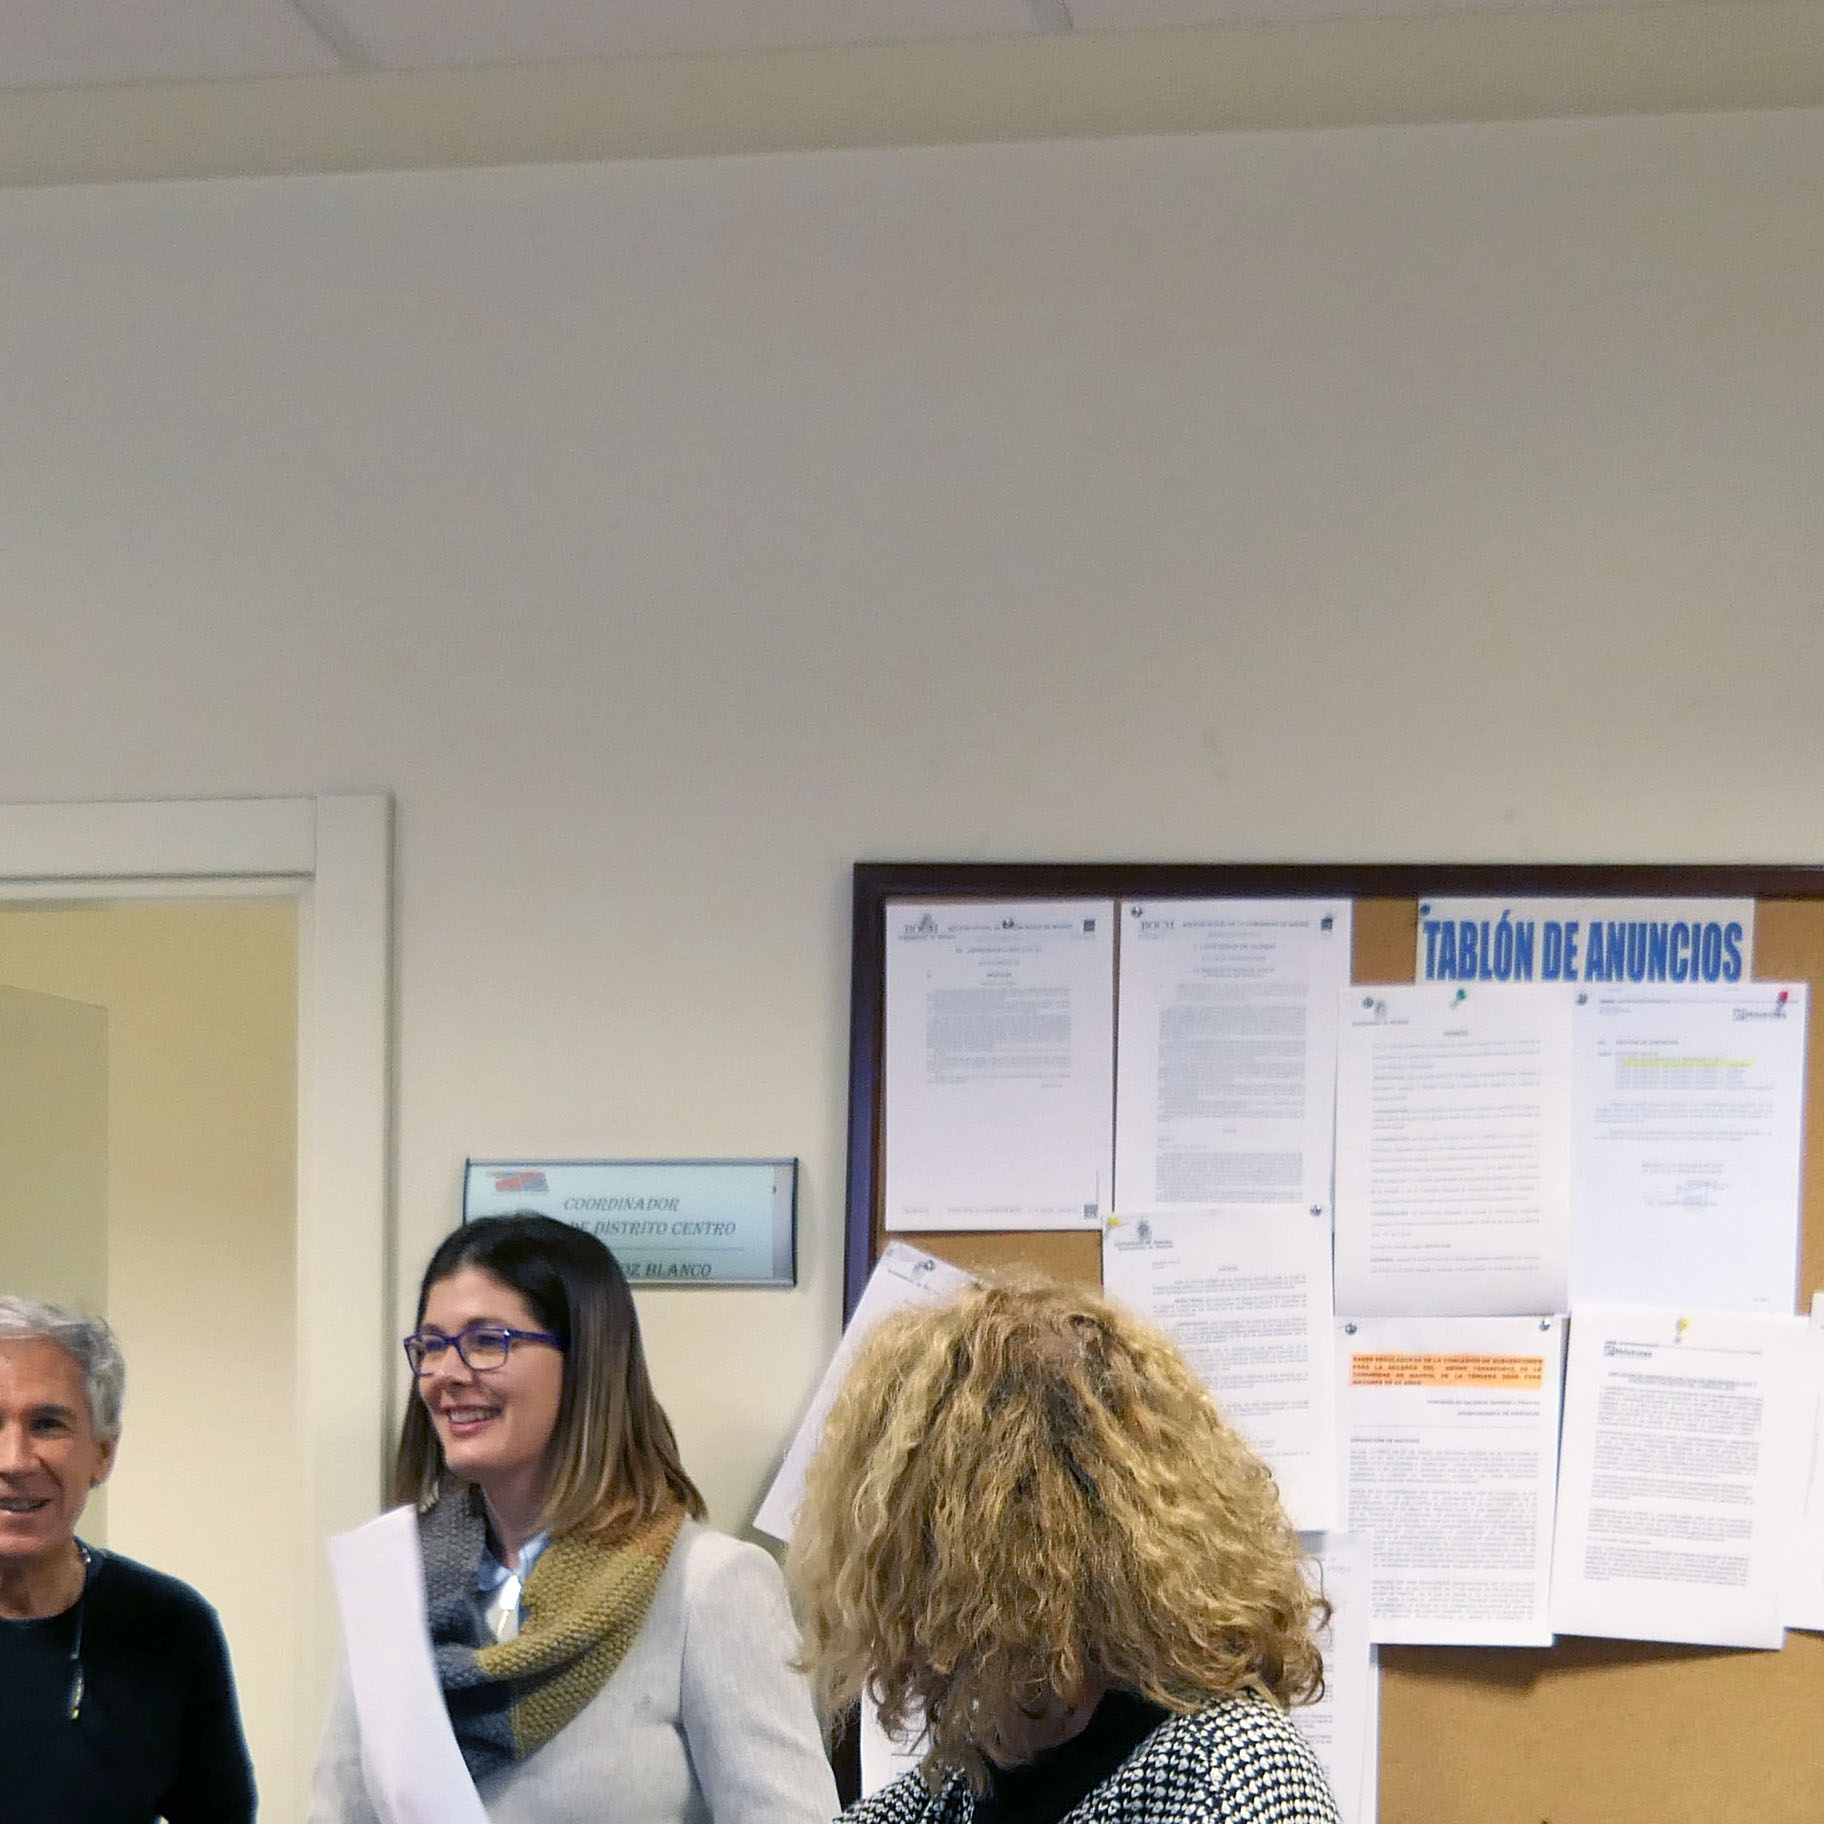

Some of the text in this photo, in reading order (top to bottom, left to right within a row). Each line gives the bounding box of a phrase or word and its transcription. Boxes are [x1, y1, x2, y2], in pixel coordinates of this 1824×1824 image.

[1424, 909, 1743, 983] TABLÓN DE ANUNCIOS
[563, 1197, 680, 1212] COORDINADOR
[593, 1221, 667, 1236] DISTRITO
[671, 1221, 736, 1236] CENTRO
[645, 1262, 712, 1277] BLANCO
